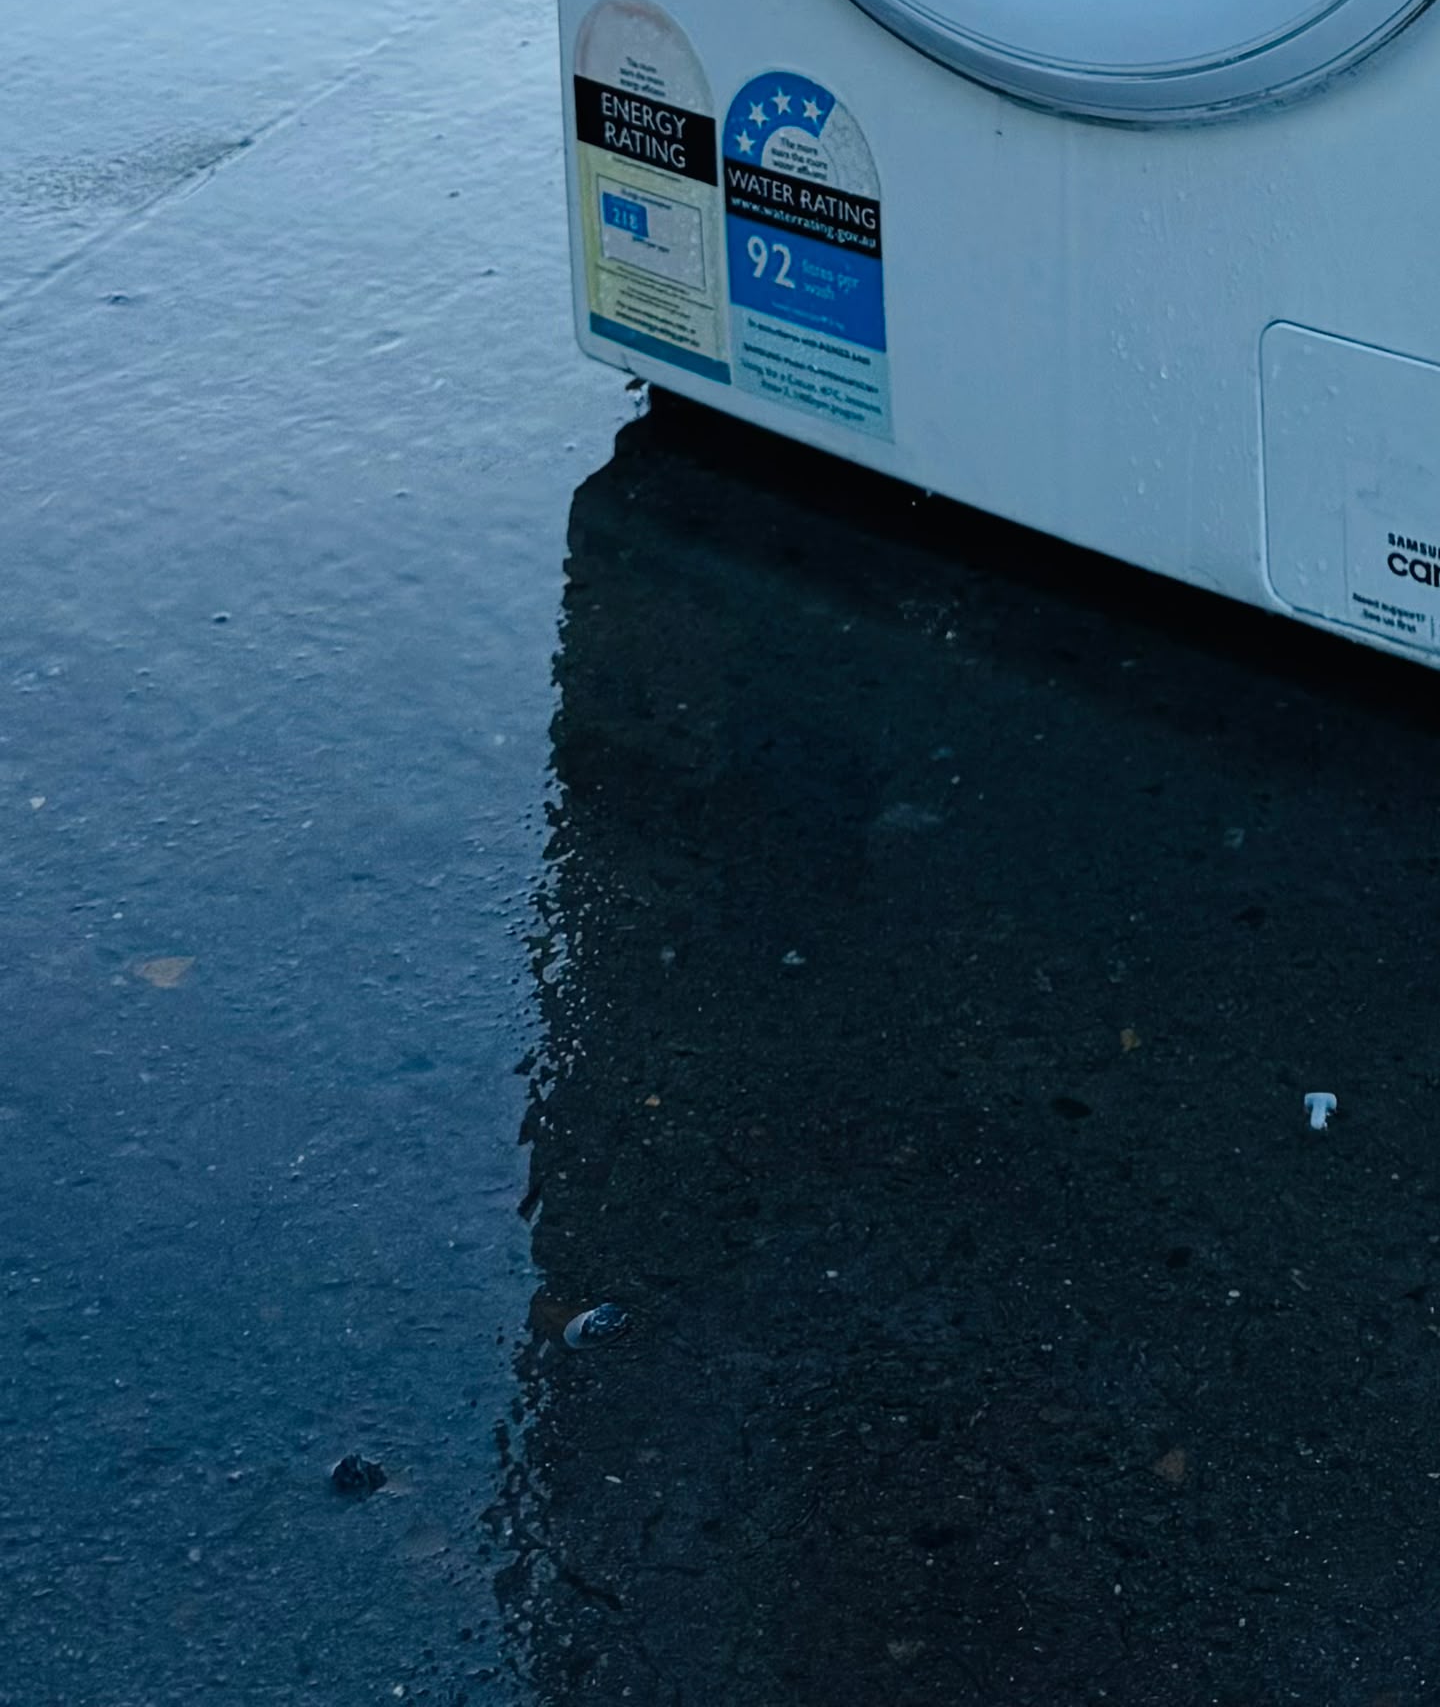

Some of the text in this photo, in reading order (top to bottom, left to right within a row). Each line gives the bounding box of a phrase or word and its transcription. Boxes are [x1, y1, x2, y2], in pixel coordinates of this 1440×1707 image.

[600, 91, 687, 139] ENERGY
[604, 120, 686, 169] RATING
[727, 166, 796, 207] WATER
[799, 188, 877, 230] RATING
[747, 234, 796, 289] 92
